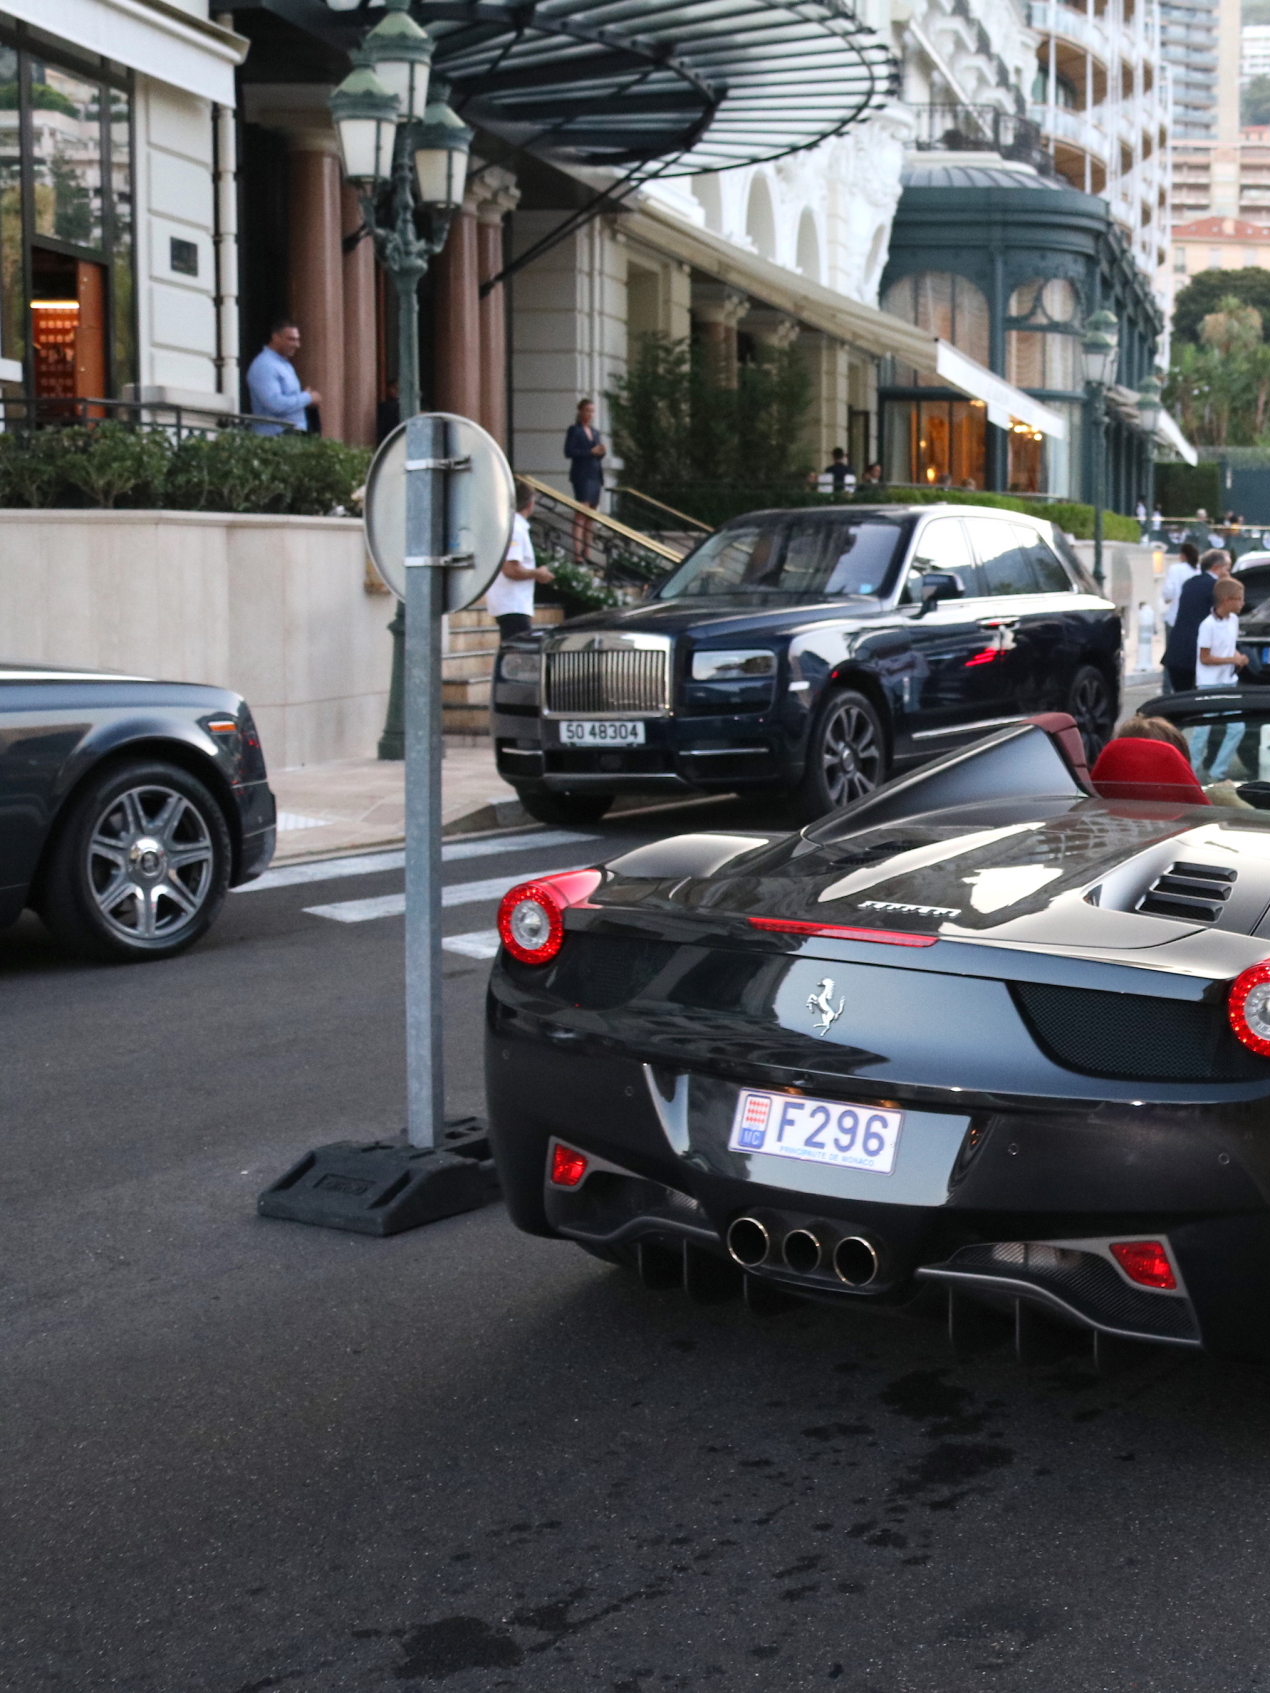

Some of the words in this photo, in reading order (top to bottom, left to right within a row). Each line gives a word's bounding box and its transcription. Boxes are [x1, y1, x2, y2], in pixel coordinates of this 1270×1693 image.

[588, 724, 639, 740] 48304
[777, 1101, 888, 1157] F296
[743, 1130, 761, 1146] MC
